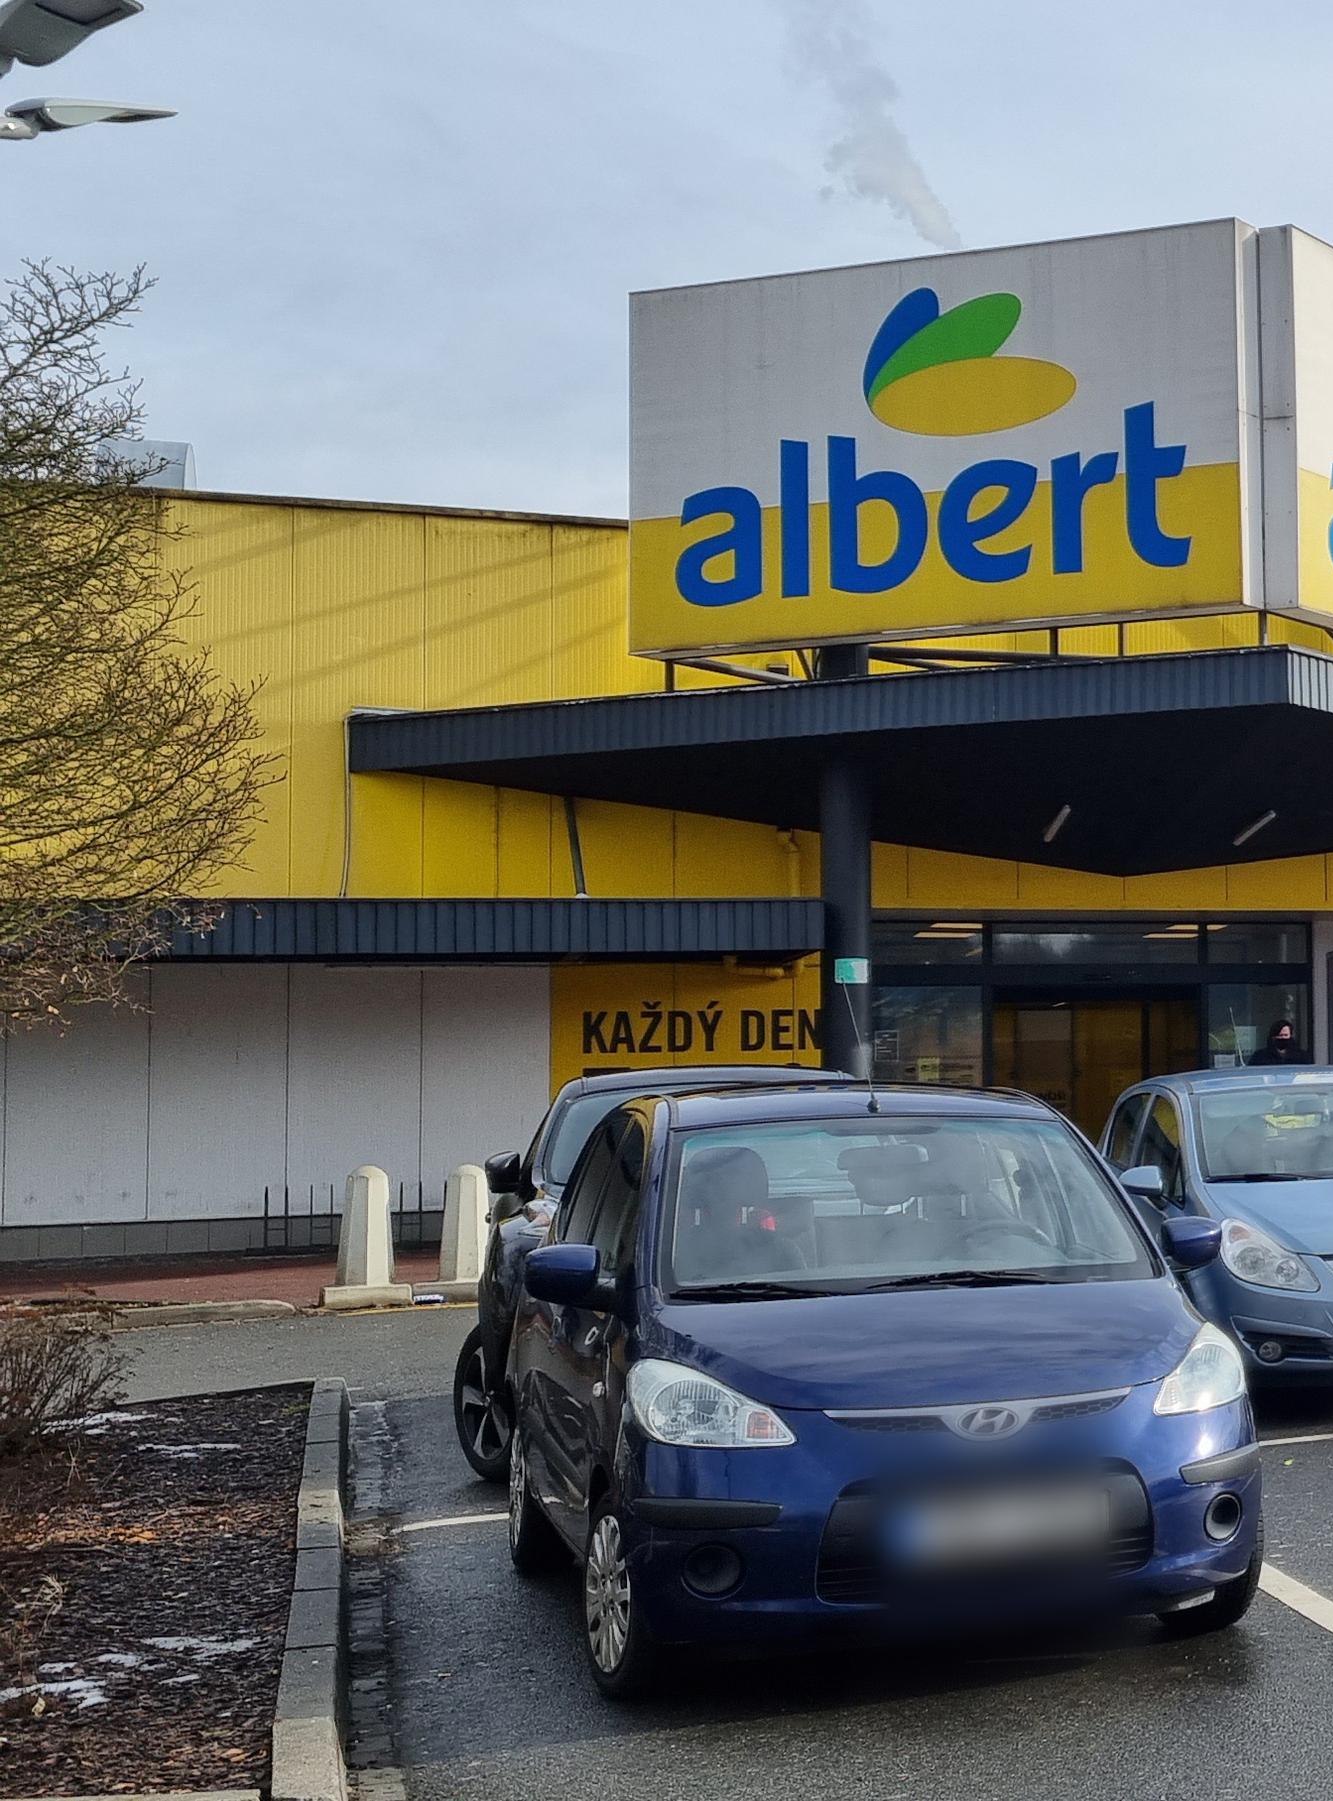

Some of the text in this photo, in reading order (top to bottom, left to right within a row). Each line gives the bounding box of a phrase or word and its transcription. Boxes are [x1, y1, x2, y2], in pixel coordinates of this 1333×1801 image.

[675, 400, 1191, 606] albert
[582, 1000, 723, 1053] KAŽDÝ
[740, 1008, 823, 1051] DEN
